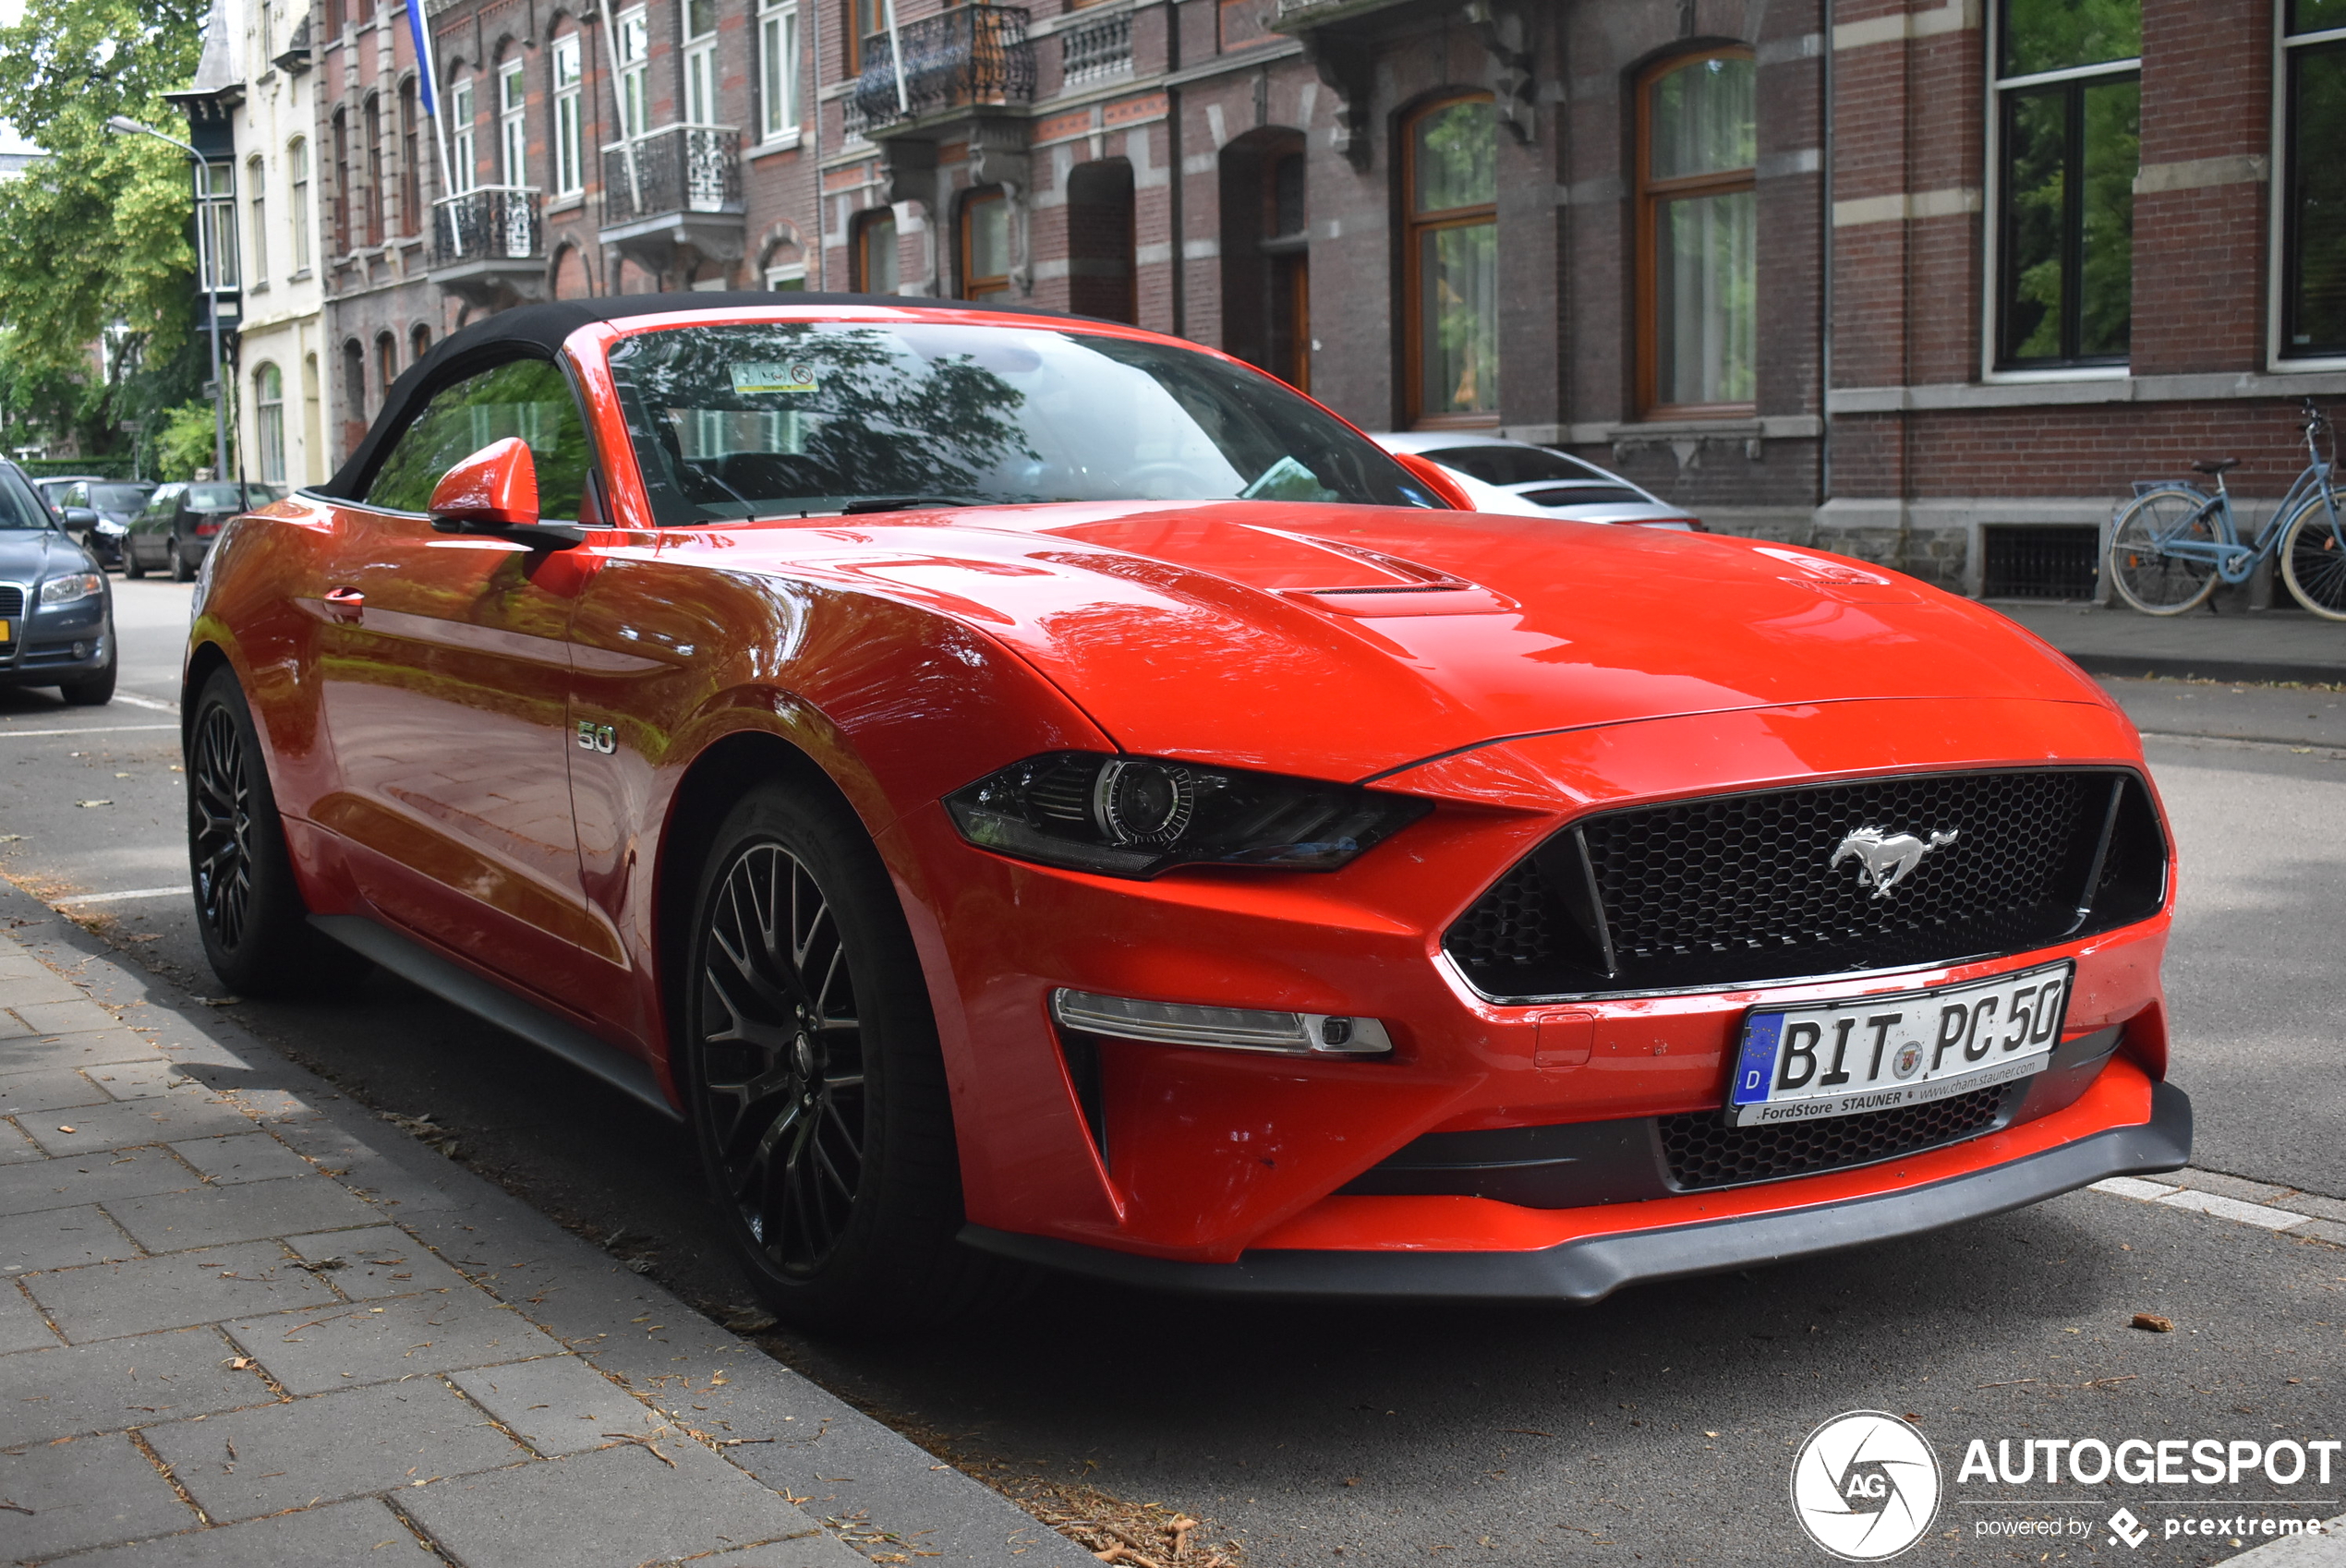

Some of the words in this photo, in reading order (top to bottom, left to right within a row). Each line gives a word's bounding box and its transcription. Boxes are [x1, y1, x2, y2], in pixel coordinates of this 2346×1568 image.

[1745, 1069, 1760, 1090] D
[1777, 1012, 1903, 1091] BIT
[1931, 995, 2000, 1071] PC
[2003, 978, 2062, 1052] 50
[1761, 1103, 1832, 1120] FordStore
[1841, 1092, 1902, 1112] STAUNER
[1919, 1061, 2036, 1100] www.cham.stauner.com
